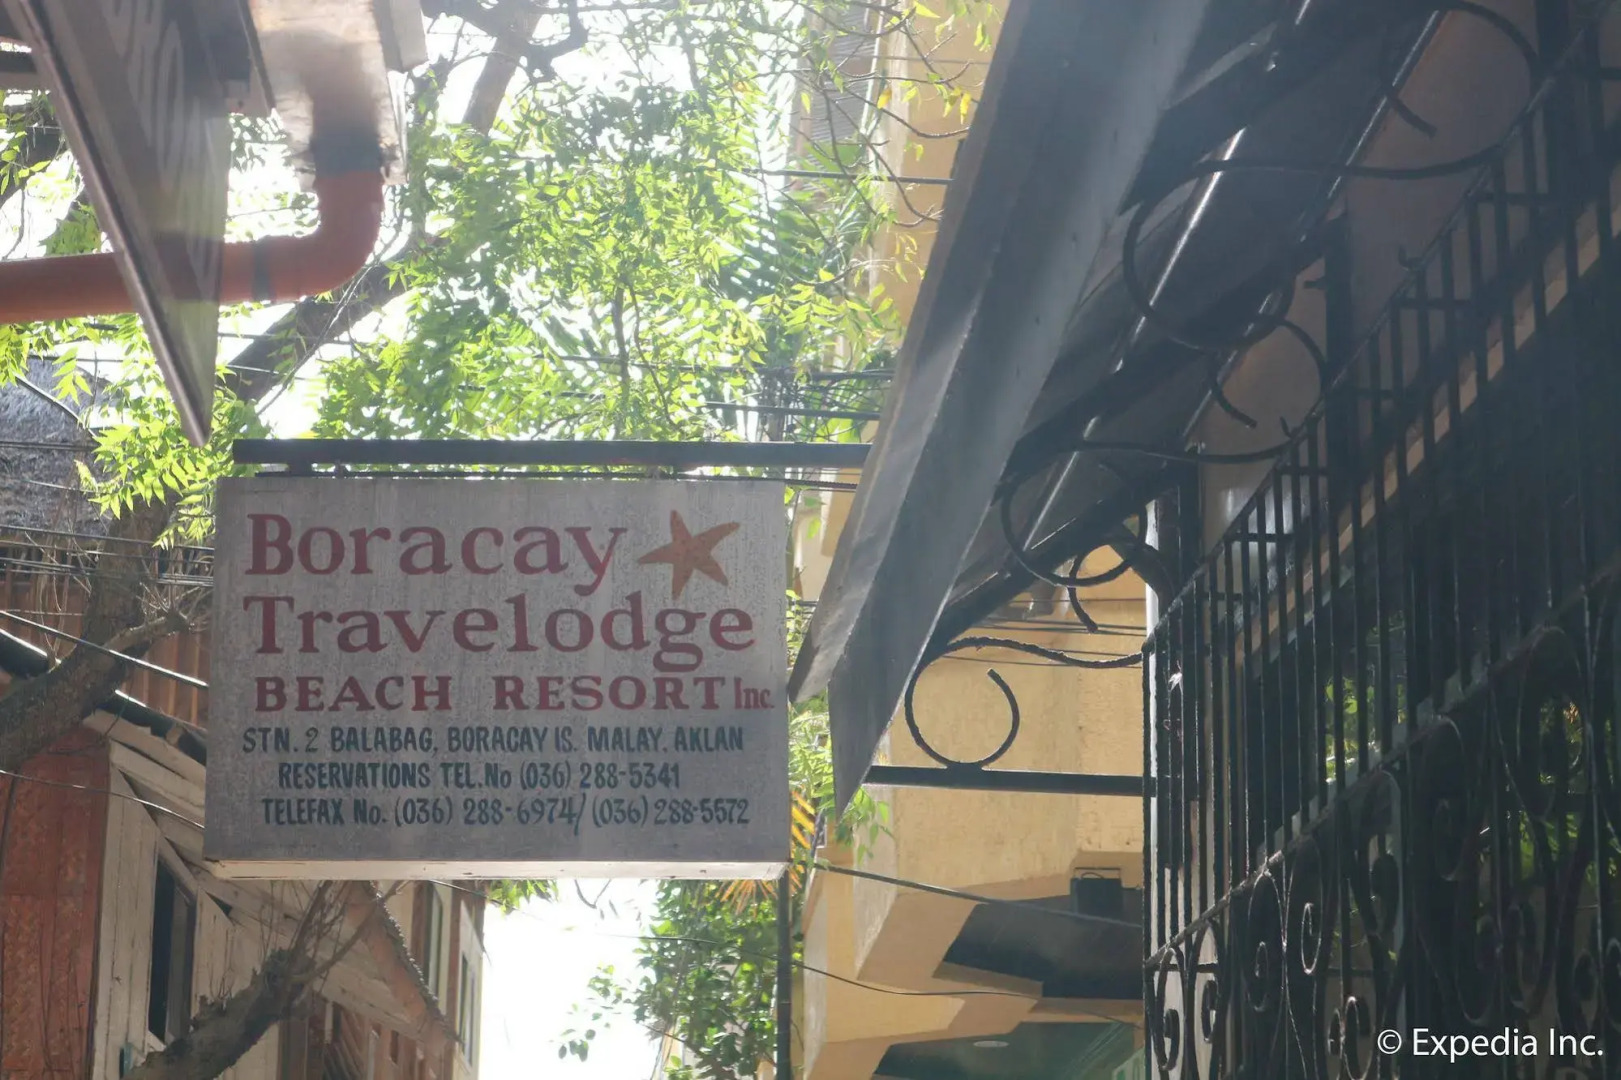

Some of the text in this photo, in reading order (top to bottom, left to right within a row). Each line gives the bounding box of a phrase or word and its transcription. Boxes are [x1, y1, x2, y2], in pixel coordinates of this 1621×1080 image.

[244, 513, 628, 596] Boracay
[243, 590, 755, 672] Travelodge
[255, 675, 452, 712] BEACH
[492, 675, 726, 711] RESORT
[243, 726, 298, 754] STN.
[305, 727, 319, 752] 2
[448, 726, 548, 752] BORACAY
[674, 726, 744, 751] AKLAN
[278, 762, 431, 789] RESERVATIONS
[520, 760, 571, 790] (036)
[579, 762, 680, 789] 288-5341
[261, 799, 346, 826] TELEFAX
[353, 799, 387, 825] No.
[394, 797, 452, 827] (036)
[653, 799, 749, 825] 288-5572
